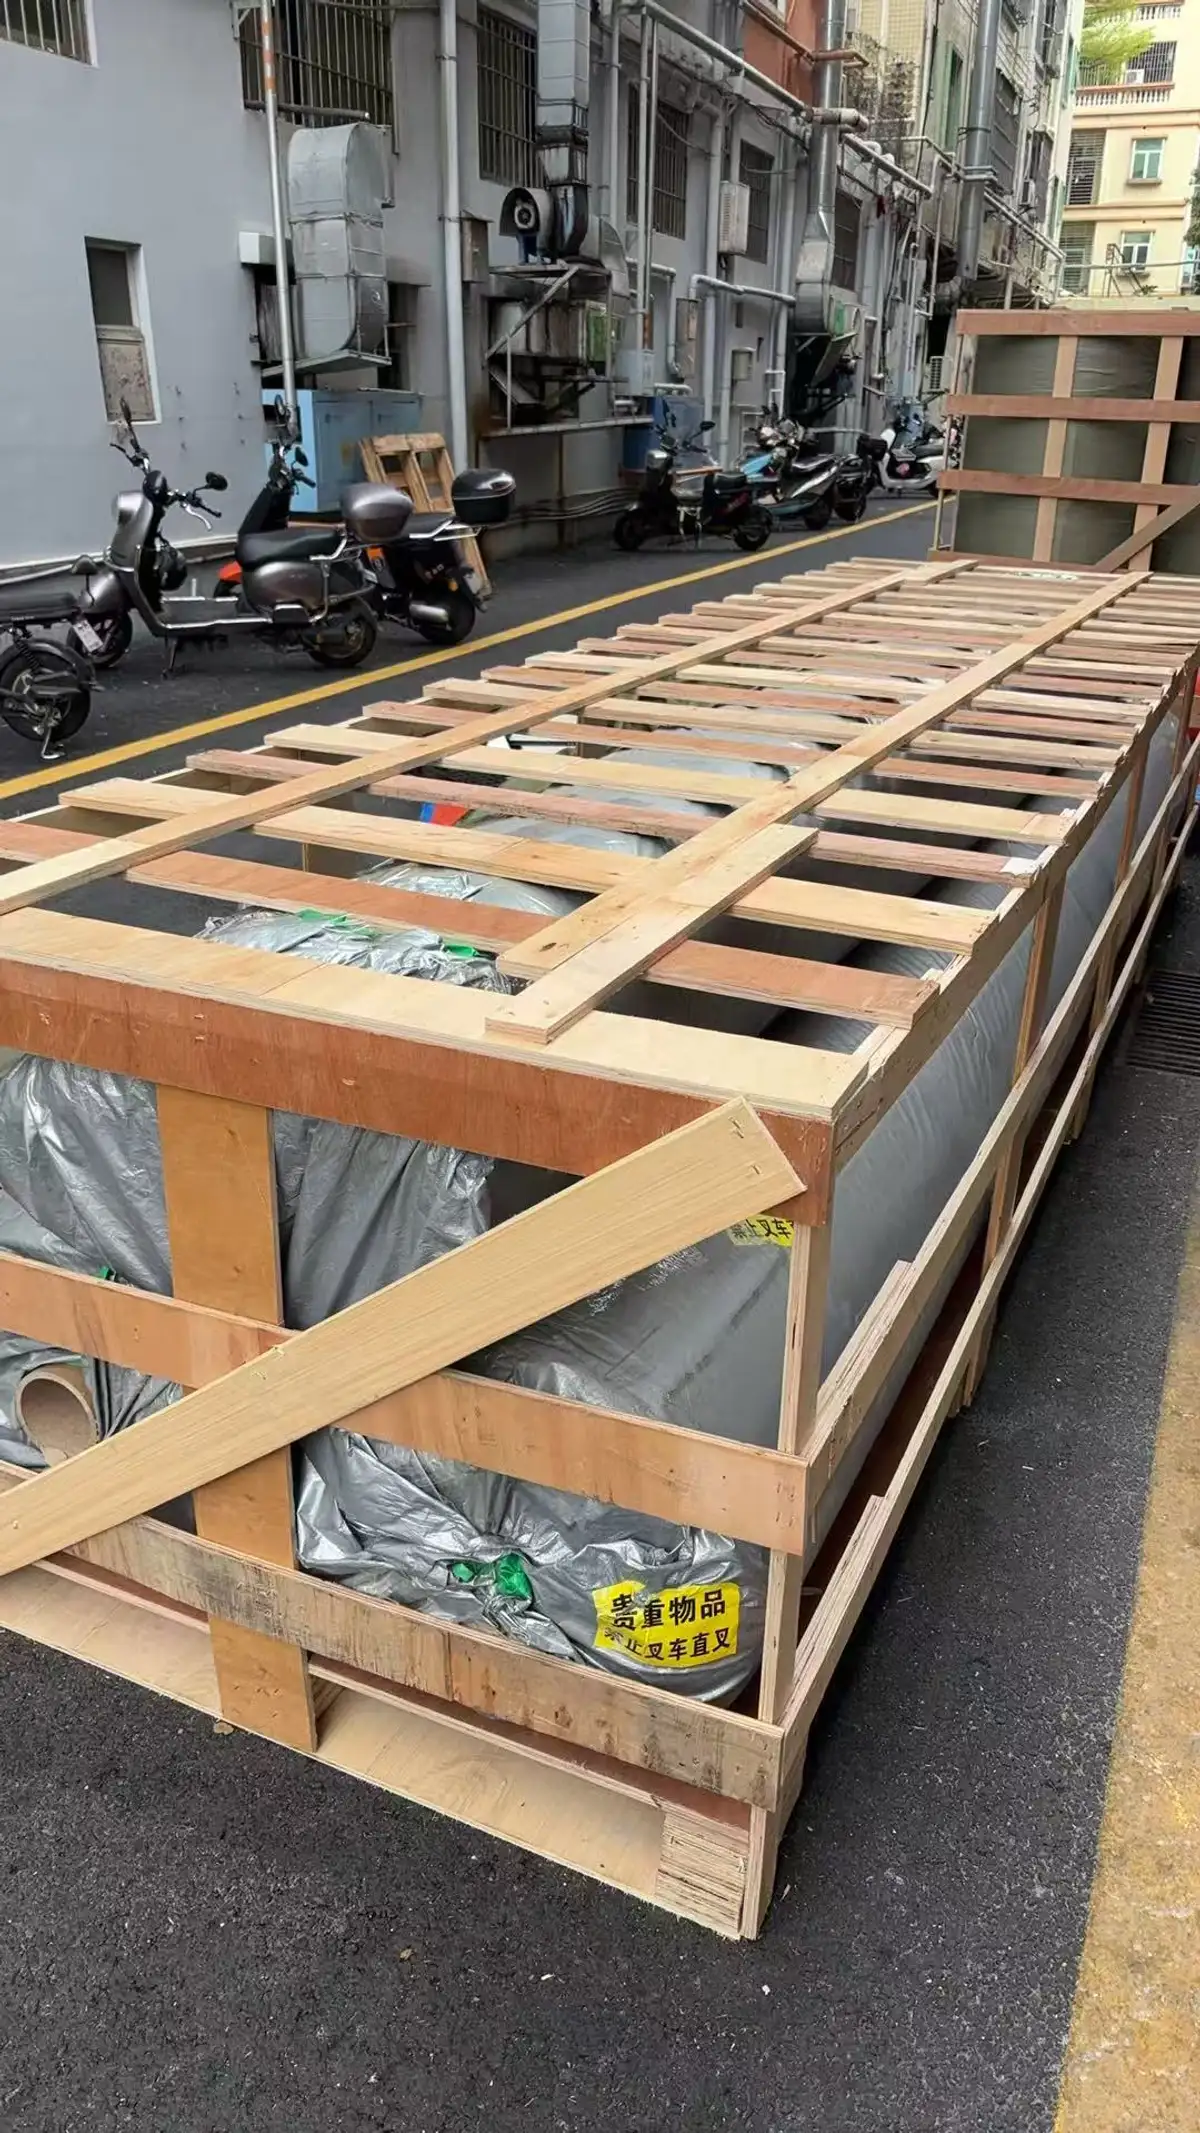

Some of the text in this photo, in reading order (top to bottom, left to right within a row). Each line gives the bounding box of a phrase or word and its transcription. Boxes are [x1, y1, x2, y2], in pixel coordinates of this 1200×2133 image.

[732, 1218, 795, 1239] 禁止叉车
[611, 1589, 726, 1631] 贵重物品
